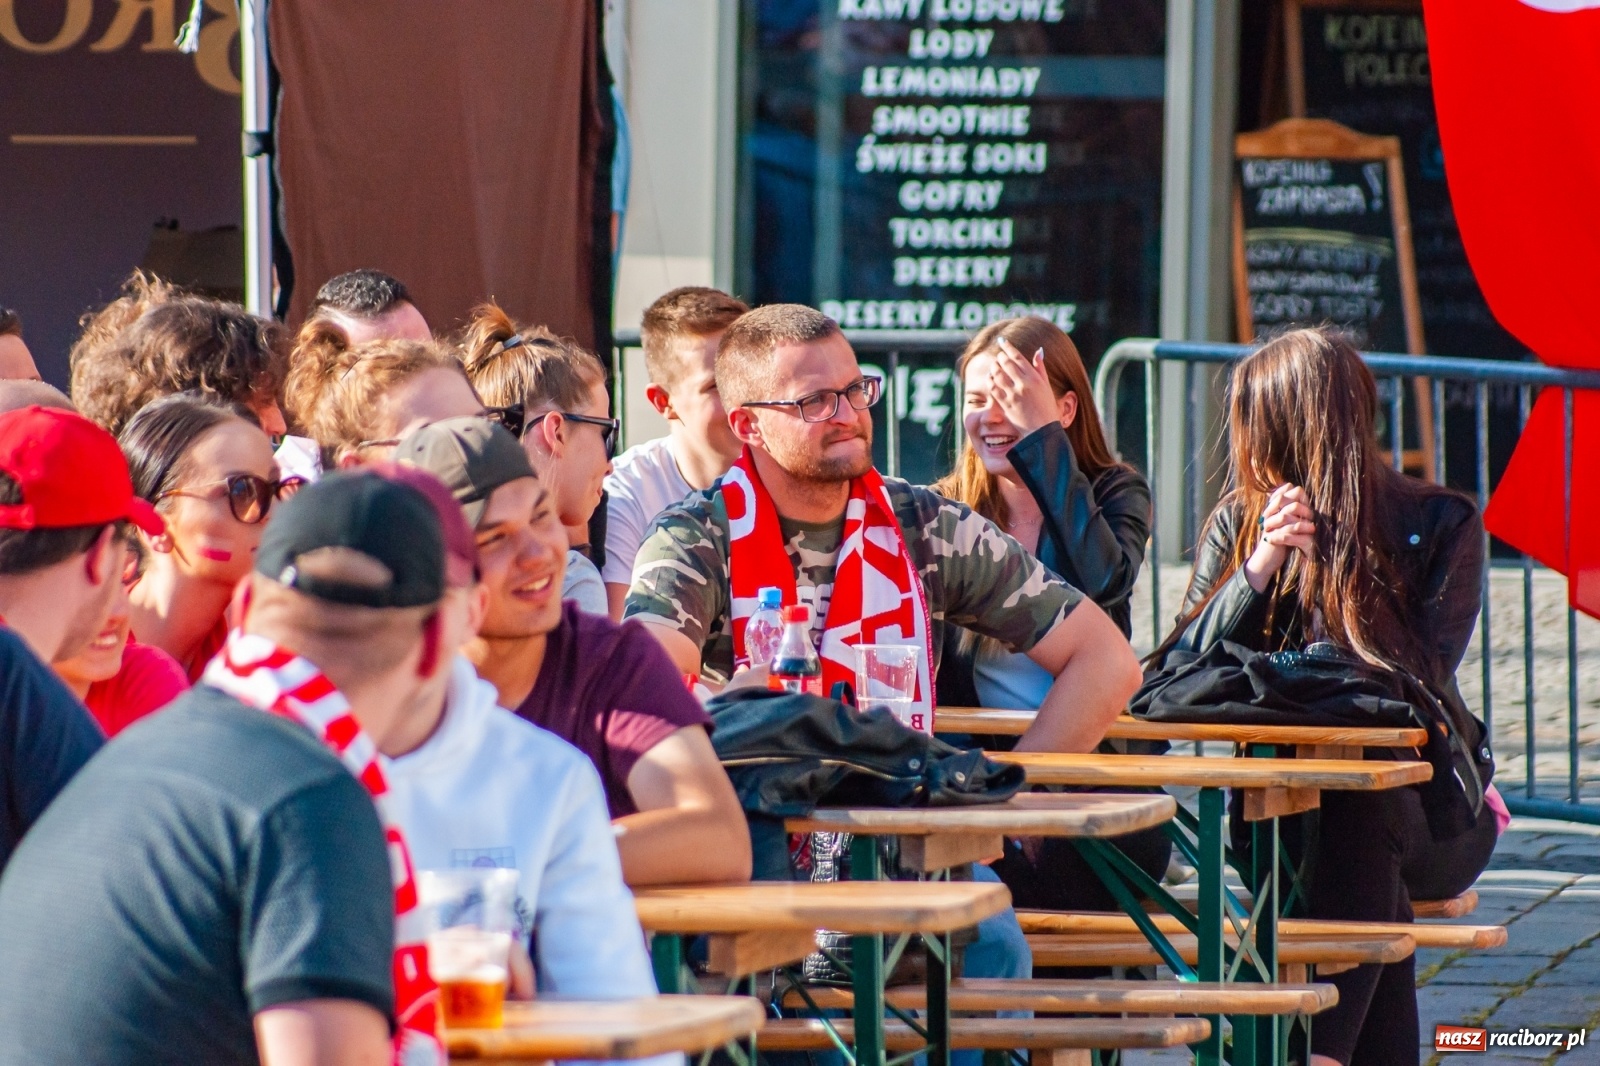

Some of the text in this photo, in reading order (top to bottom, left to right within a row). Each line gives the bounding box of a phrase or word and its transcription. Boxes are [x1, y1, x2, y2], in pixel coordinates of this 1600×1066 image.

[838, 0, 1064, 21] KAWY LODOWE
[909, 29, 995, 59] LODY
[861, 66, 1041, 97] LEMONIADY
[872, 105, 1031, 136] SMOOTHIE
[856, 135, 1047, 174] ŚWIEŻE SOKI
[899, 180, 1003, 211] GOFRY
[890, 218, 1014, 249] TORCIKI
[893, 256, 1011, 287] DESERY
[822, 301, 934, 330] DESERY
